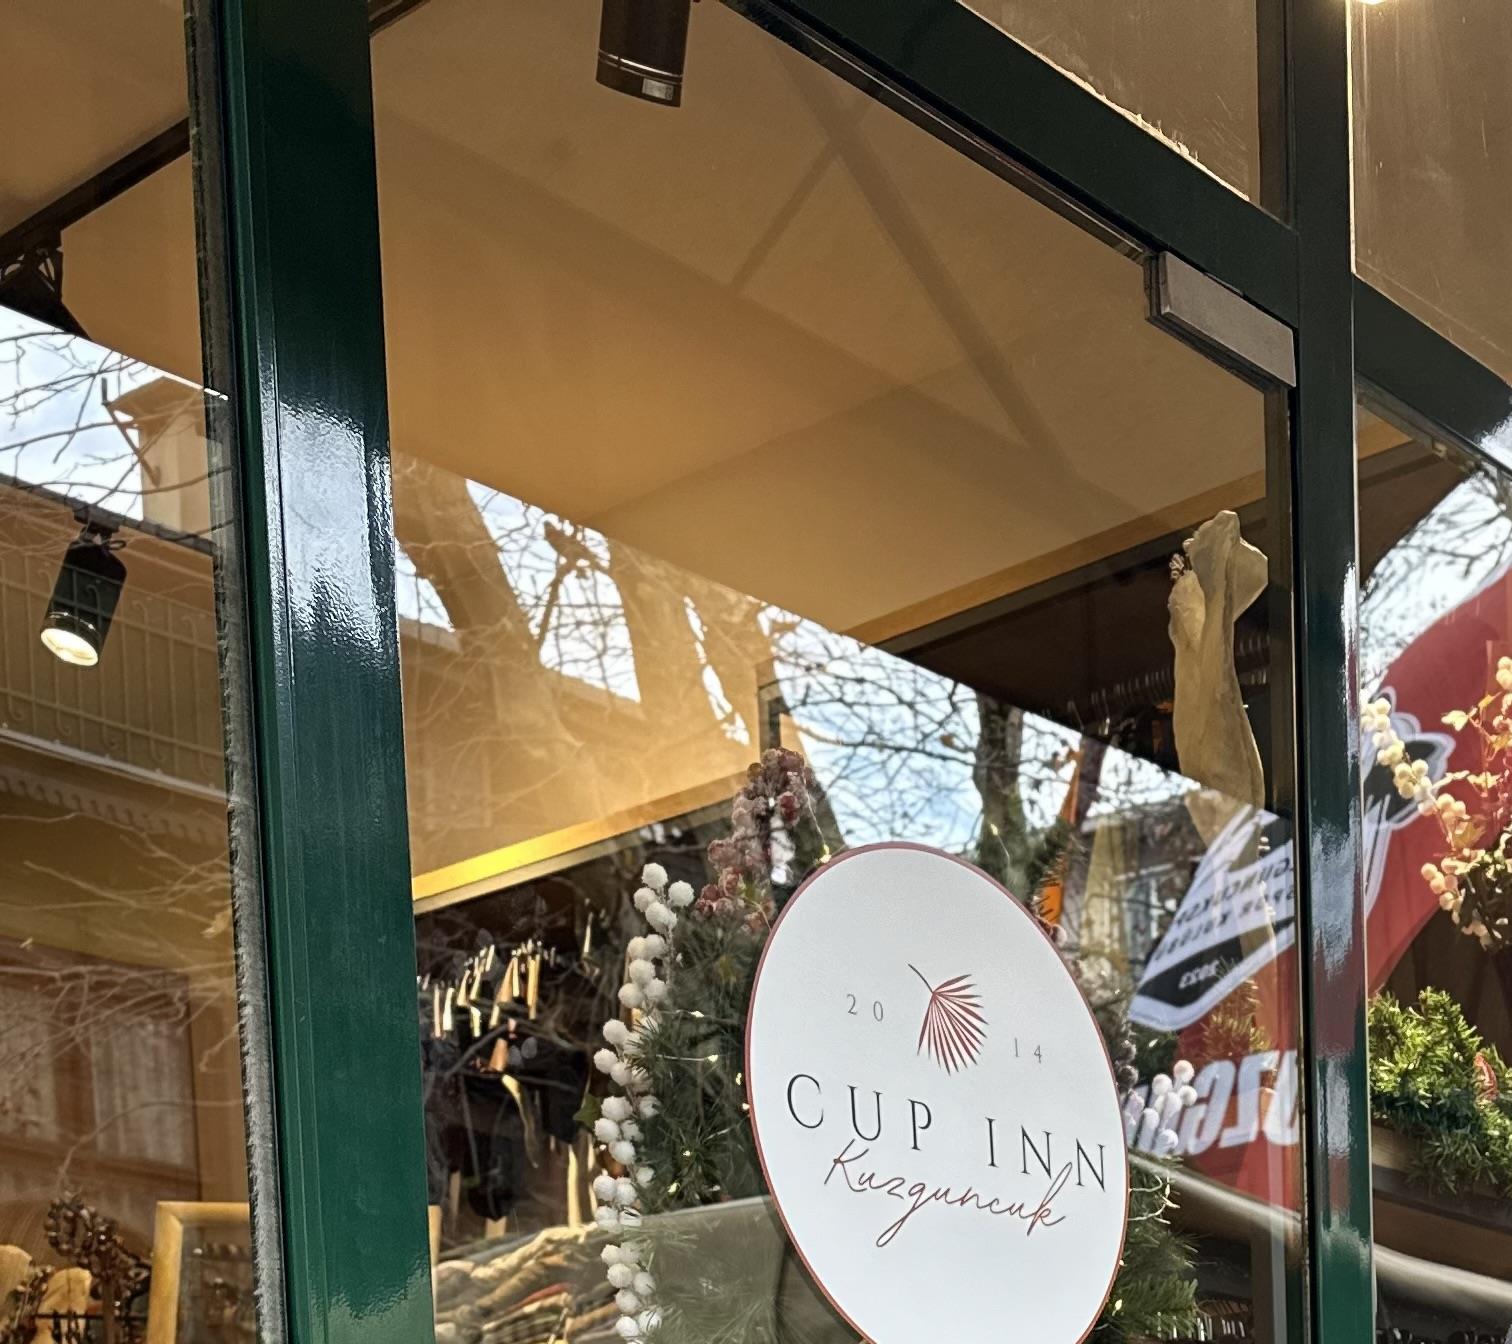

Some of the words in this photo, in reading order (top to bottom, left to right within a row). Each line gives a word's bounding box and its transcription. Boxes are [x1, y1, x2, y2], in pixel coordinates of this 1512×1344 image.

[847, 993, 884, 1022] 20
[1014, 1038, 1043, 1064] 14
[787, 1074, 933, 1151] CUP
[985, 1116, 1107, 1192] INN
[823, 1139, 1072, 1247] Kuzguncuk
